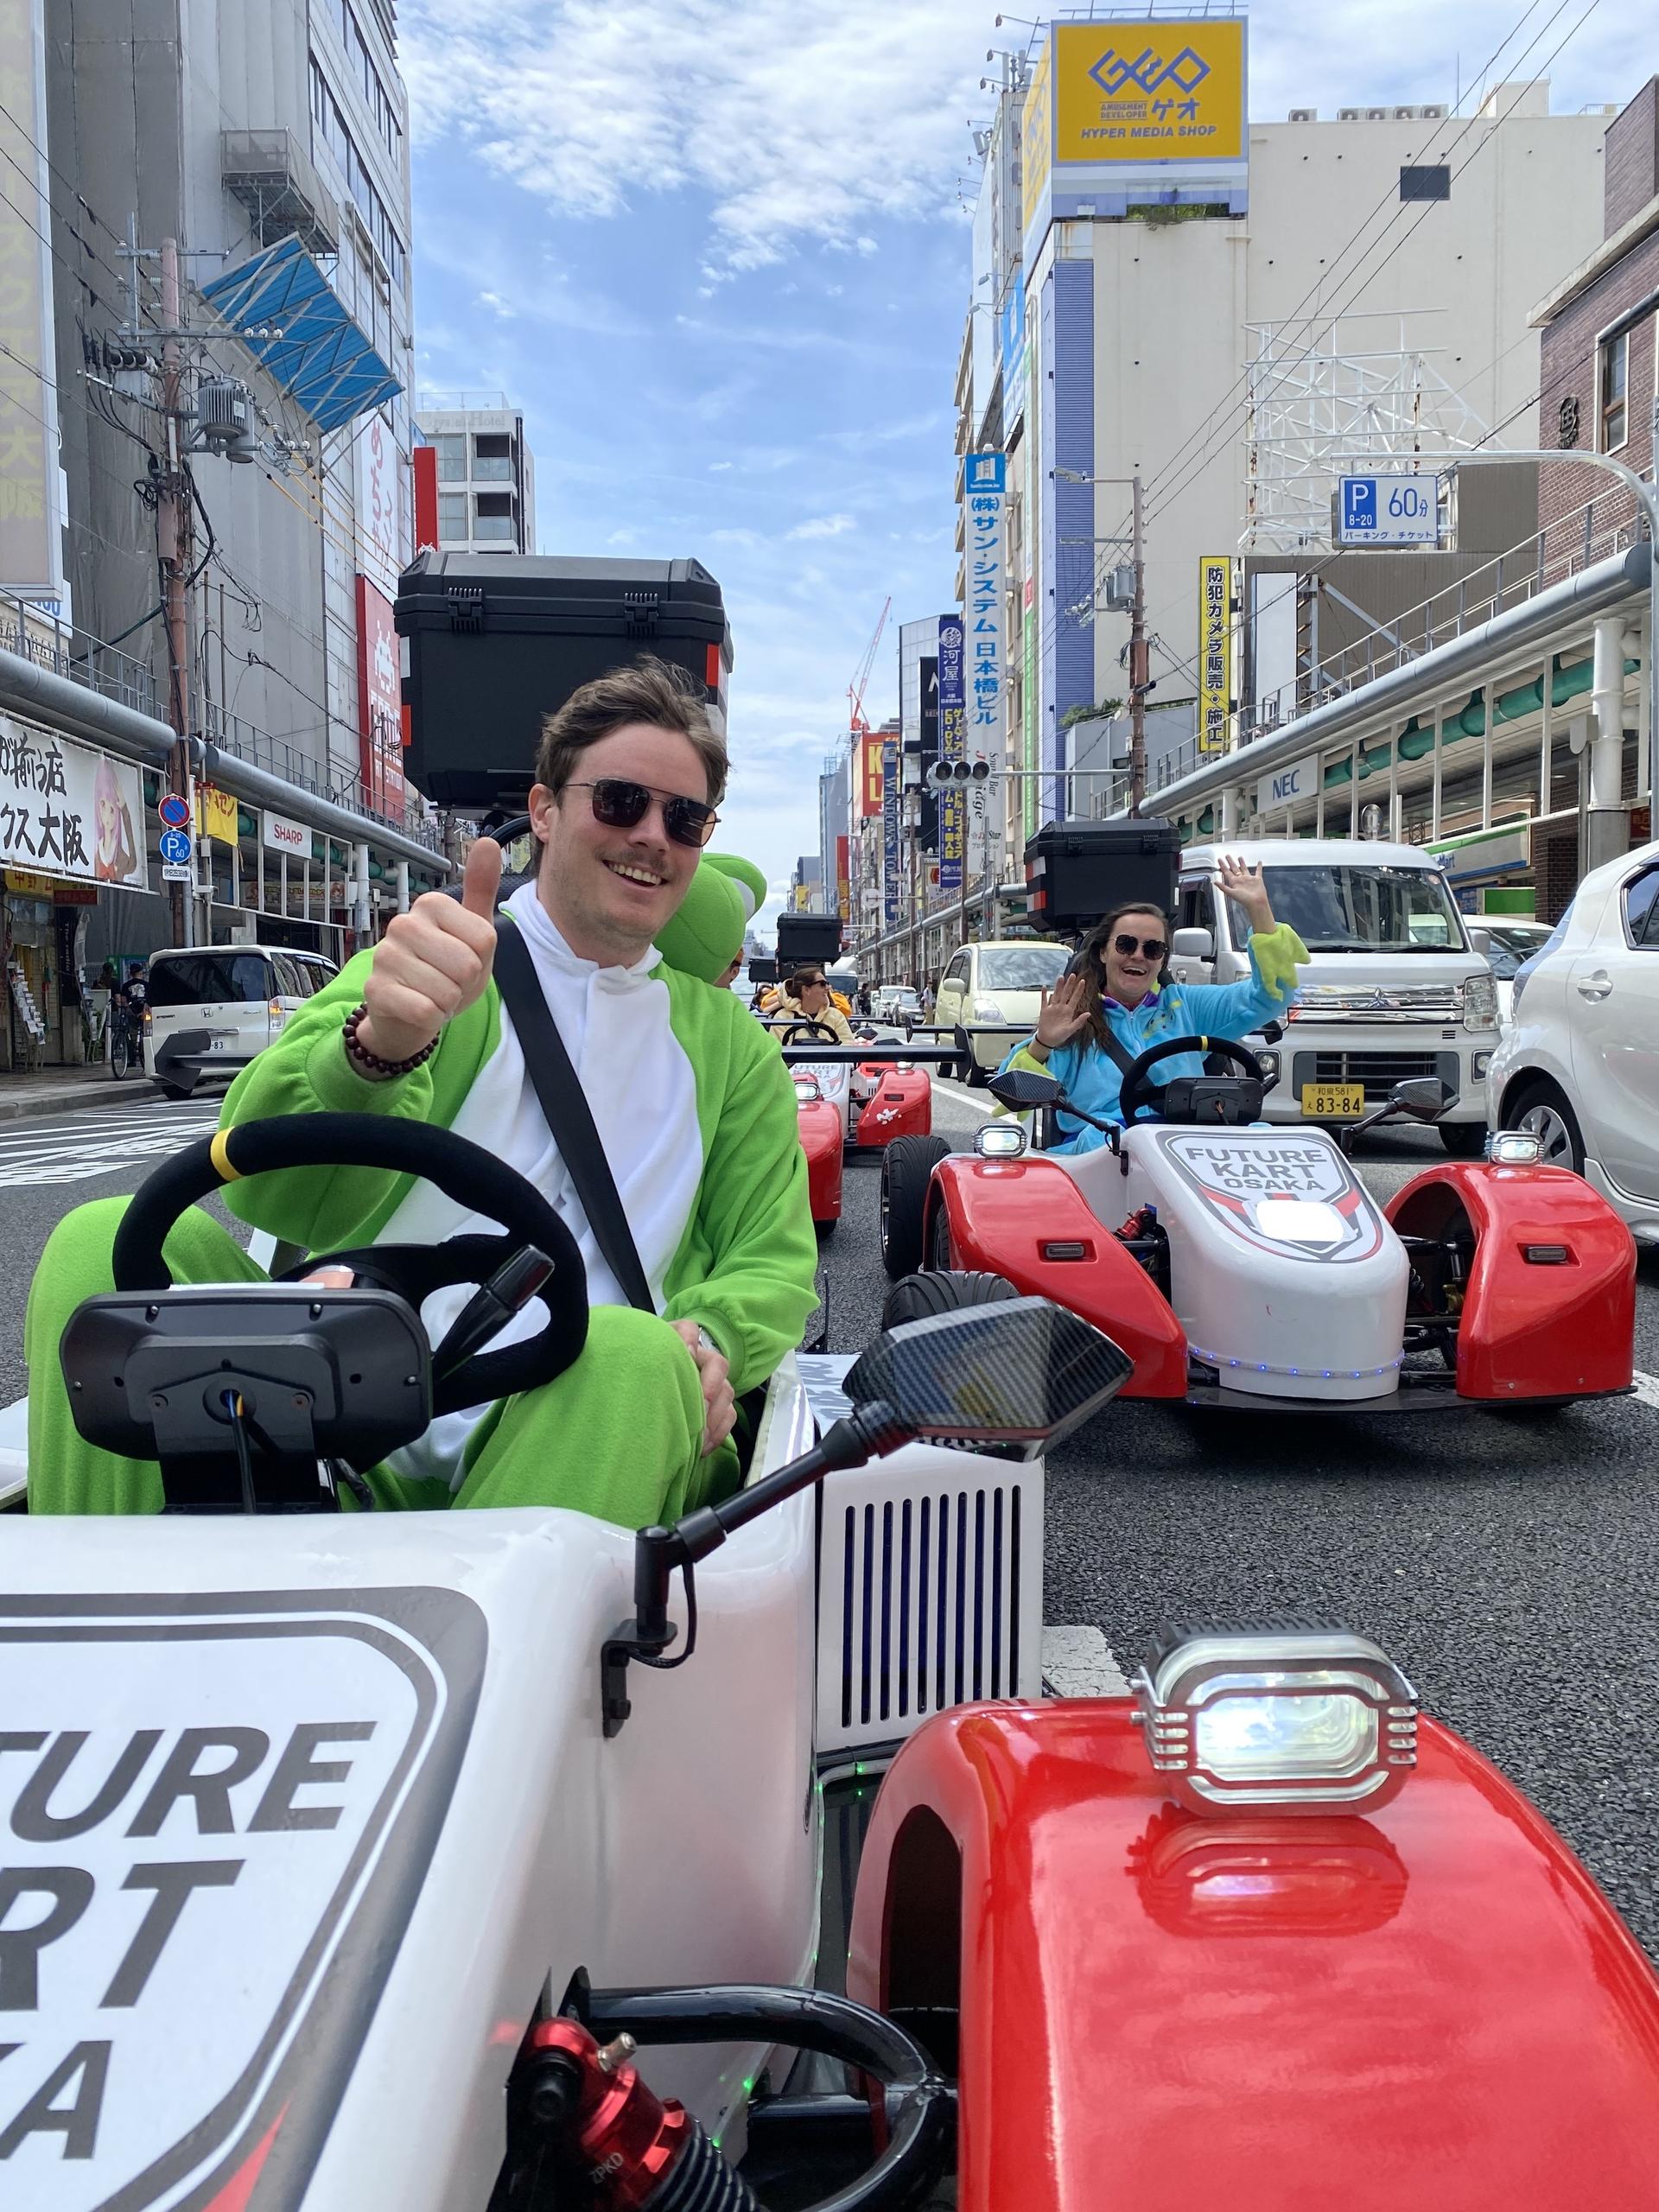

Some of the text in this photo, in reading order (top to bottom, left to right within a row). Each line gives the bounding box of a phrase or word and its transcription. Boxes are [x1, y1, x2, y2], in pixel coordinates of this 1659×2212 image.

[1087, 46, 1211, 96] GEO
[1100, 102, 1147, 111] AMUSEMENT
[1100, 111, 1147, 119] DEVELOPER
[1151, 98, 1200, 121] ゲオ
[1081, 125, 1217, 139] HYPER MEDIA SHOP
[1352, 484, 1370, 512] P
[1389, 487, 1428, 518] 60分
[1349, 514, 1373, 526] 8-20
[1344, 531, 1433, 540] パーキング・チケット
[1206, 566, 1224, 743] 防犯カメラ販売・施工
[988, 780, 999, 797] Bar
[1273, 768, 1300, 801] NEC
[885, 776, 897, 842] WINDOWS
[274, 823, 303, 845] SHARP
[168, 837, 180, 858] P
[1437, 850, 1456, 868] Mart
[1316, 1097, 1361, 1114] 83-84
[1185, 1147, 1327, 1163] FUTURE
[1211, 1162, 1315, 1179] KART
[1224, 1178, 1326, 1191] OSAKA
[0, 2039, 113, 2160] A
